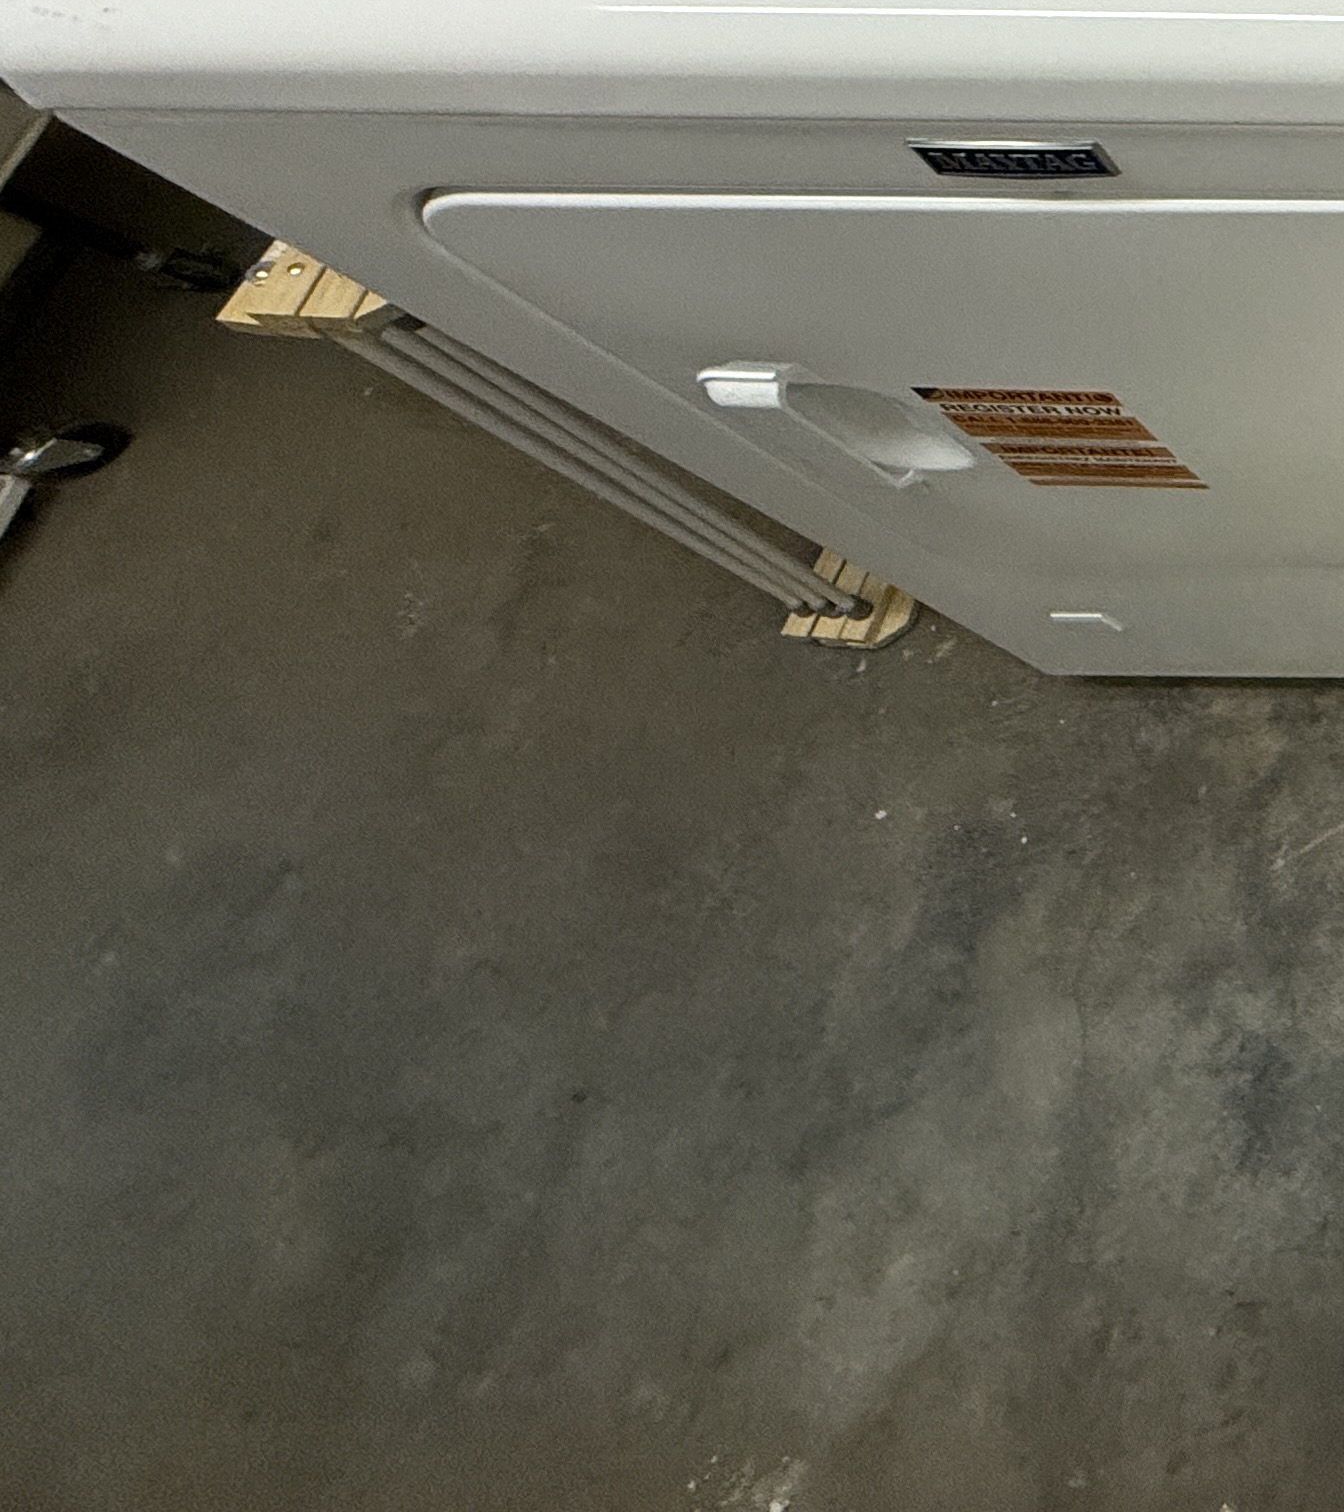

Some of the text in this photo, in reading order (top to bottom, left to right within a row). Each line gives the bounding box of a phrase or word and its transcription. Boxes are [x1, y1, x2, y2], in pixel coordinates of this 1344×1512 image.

[927, 151, 1098, 171] MAYTAG
[940, 403, 1121, 416] REGISTER NOW
